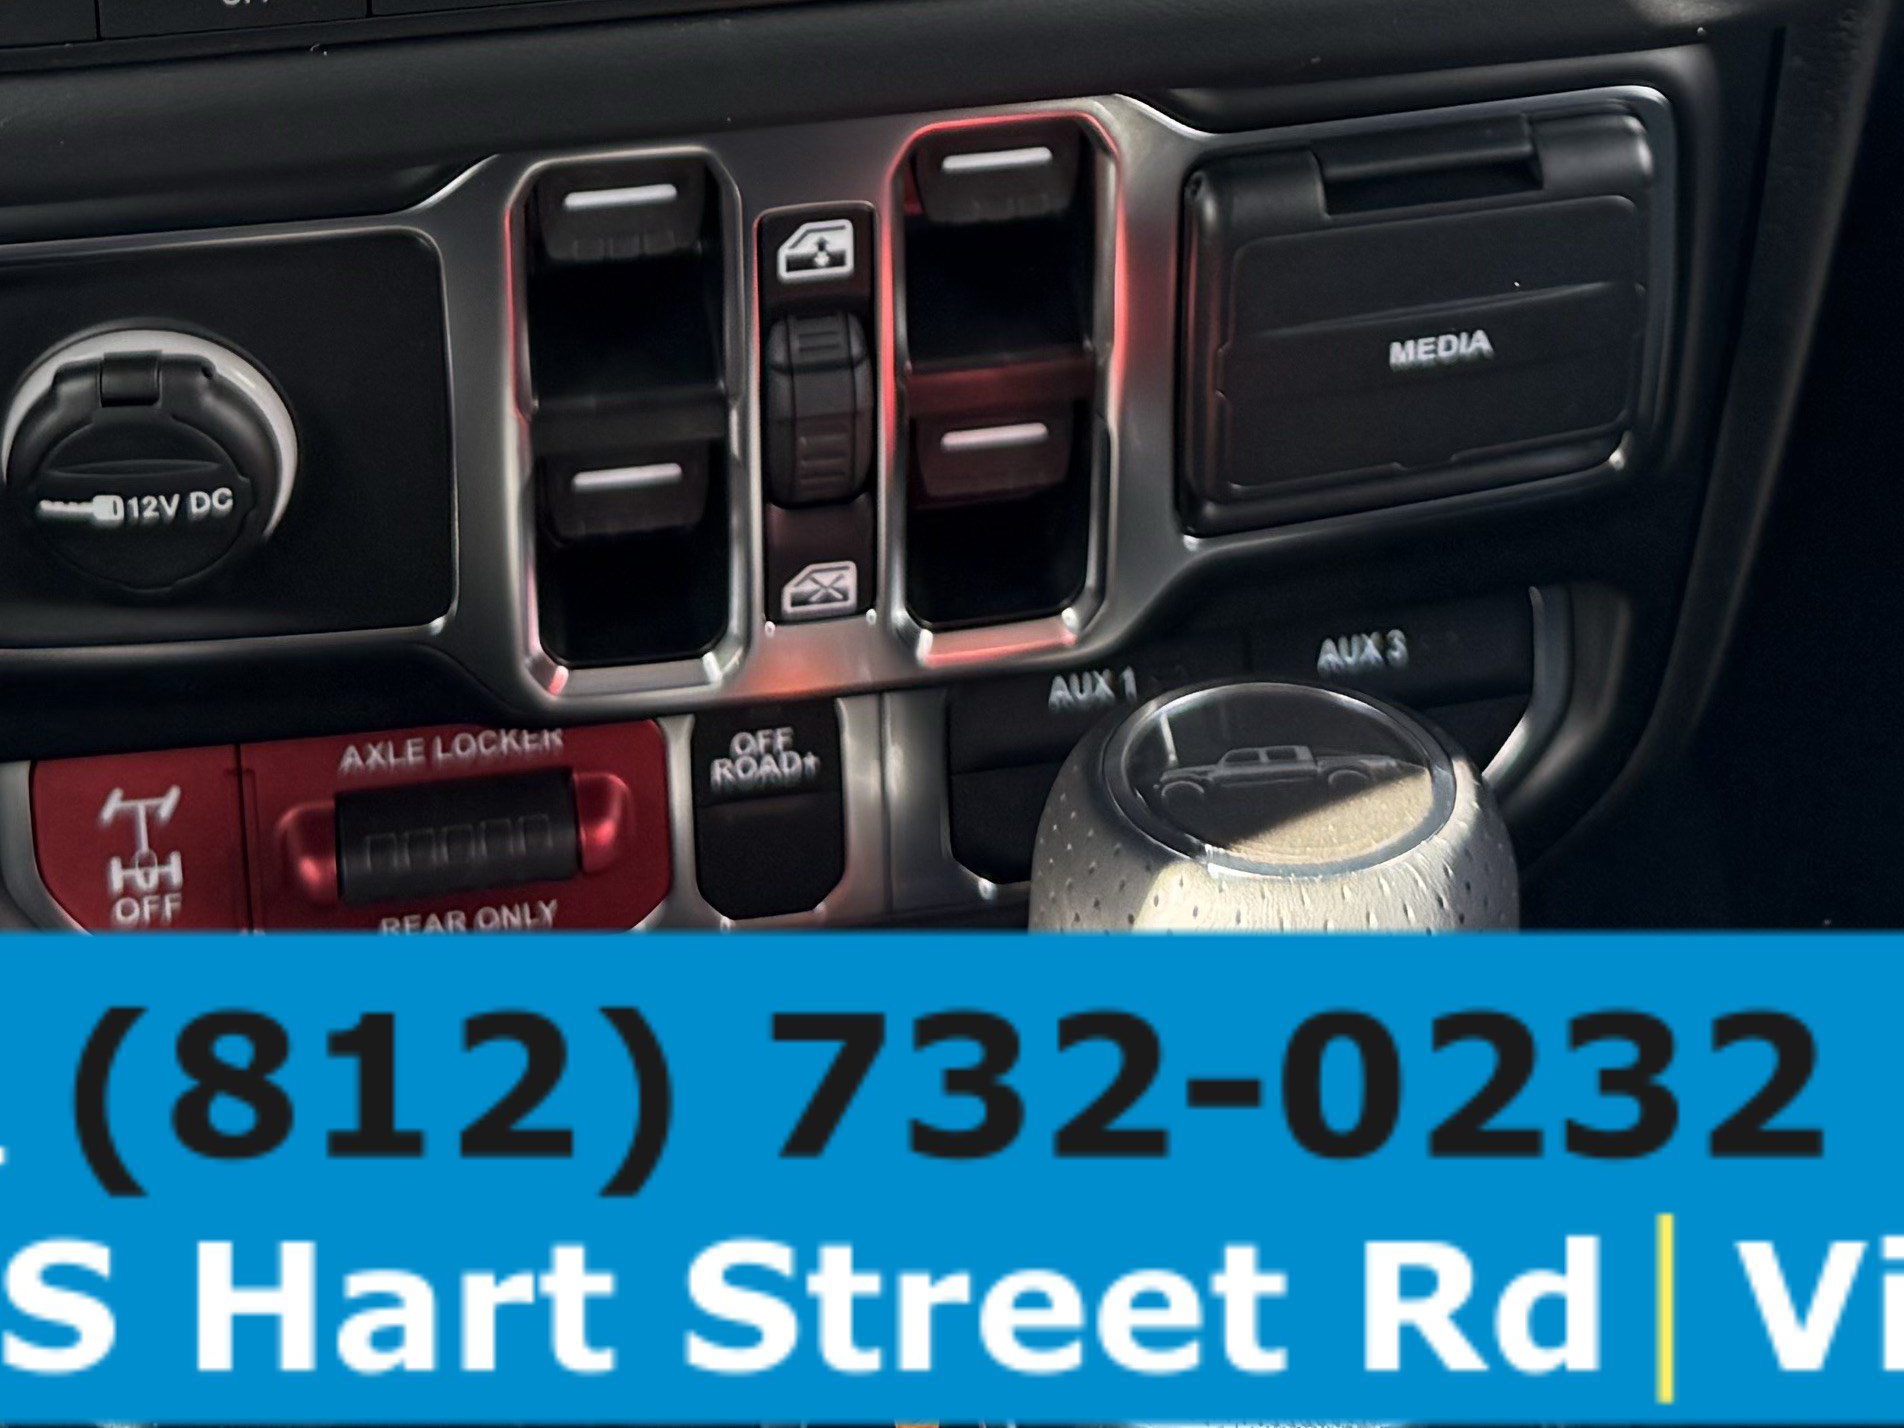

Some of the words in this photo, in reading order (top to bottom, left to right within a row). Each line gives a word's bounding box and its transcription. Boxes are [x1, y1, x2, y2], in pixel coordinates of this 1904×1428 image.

[1387, 328, 1494, 370] MEDIA
[127, 493, 181, 523] 12V
[188, 486, 235, 517] DC
[1315, 634, 1383, 674] AUX
[1390, 629, 1408, 666] 3
[1047, 672, 1115, 710] AUX
[1123, 665, 1138, 700] 1
[338, 736, 426, 774] AXLE
[433, 727, 565, 763] LOCKER
[730, 726, 795, 759] OFF
[112, 892, 183, 927] OFF
[473, 897, 560, 932] ONLY
